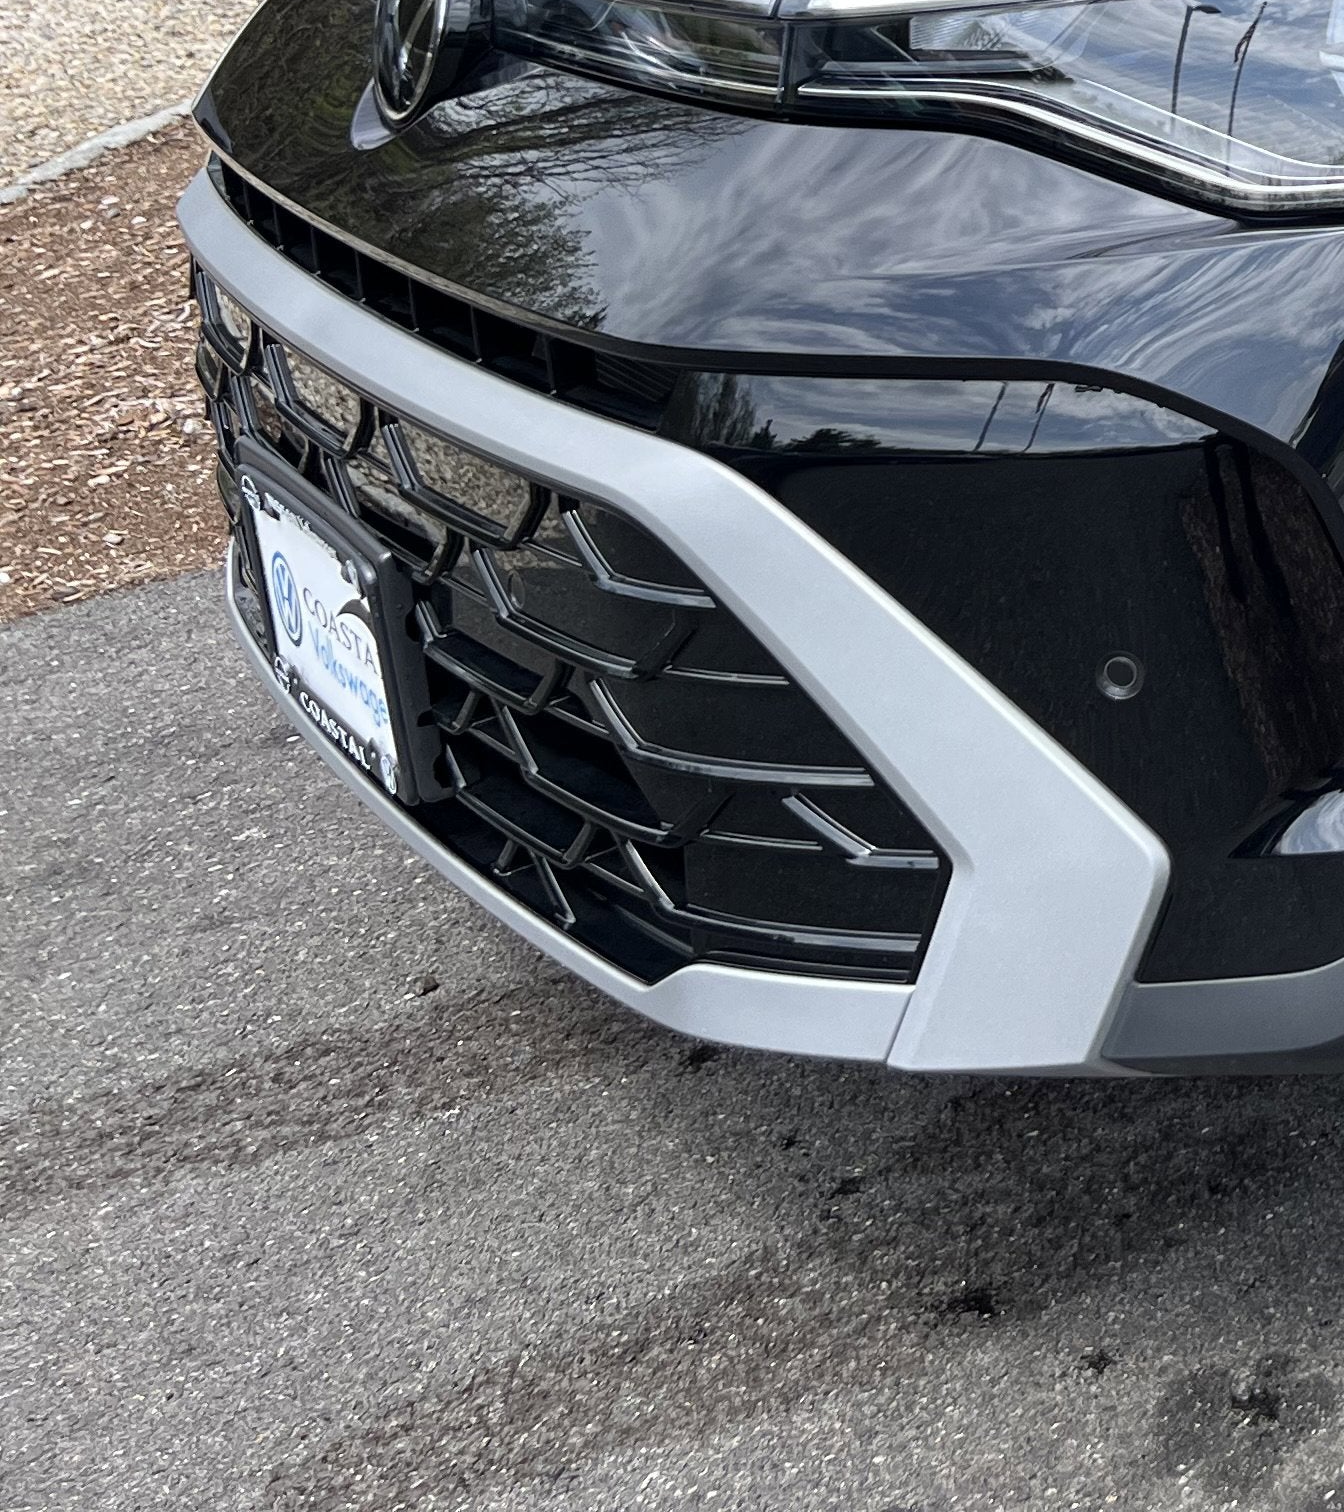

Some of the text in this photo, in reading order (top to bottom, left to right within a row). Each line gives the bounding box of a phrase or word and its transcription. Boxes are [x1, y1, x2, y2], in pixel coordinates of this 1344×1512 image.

[303, 587, 379, 675] COASTA
[307, 620, 389, 728] Volkswage
[299, 691, 372, 771] COASTAL
